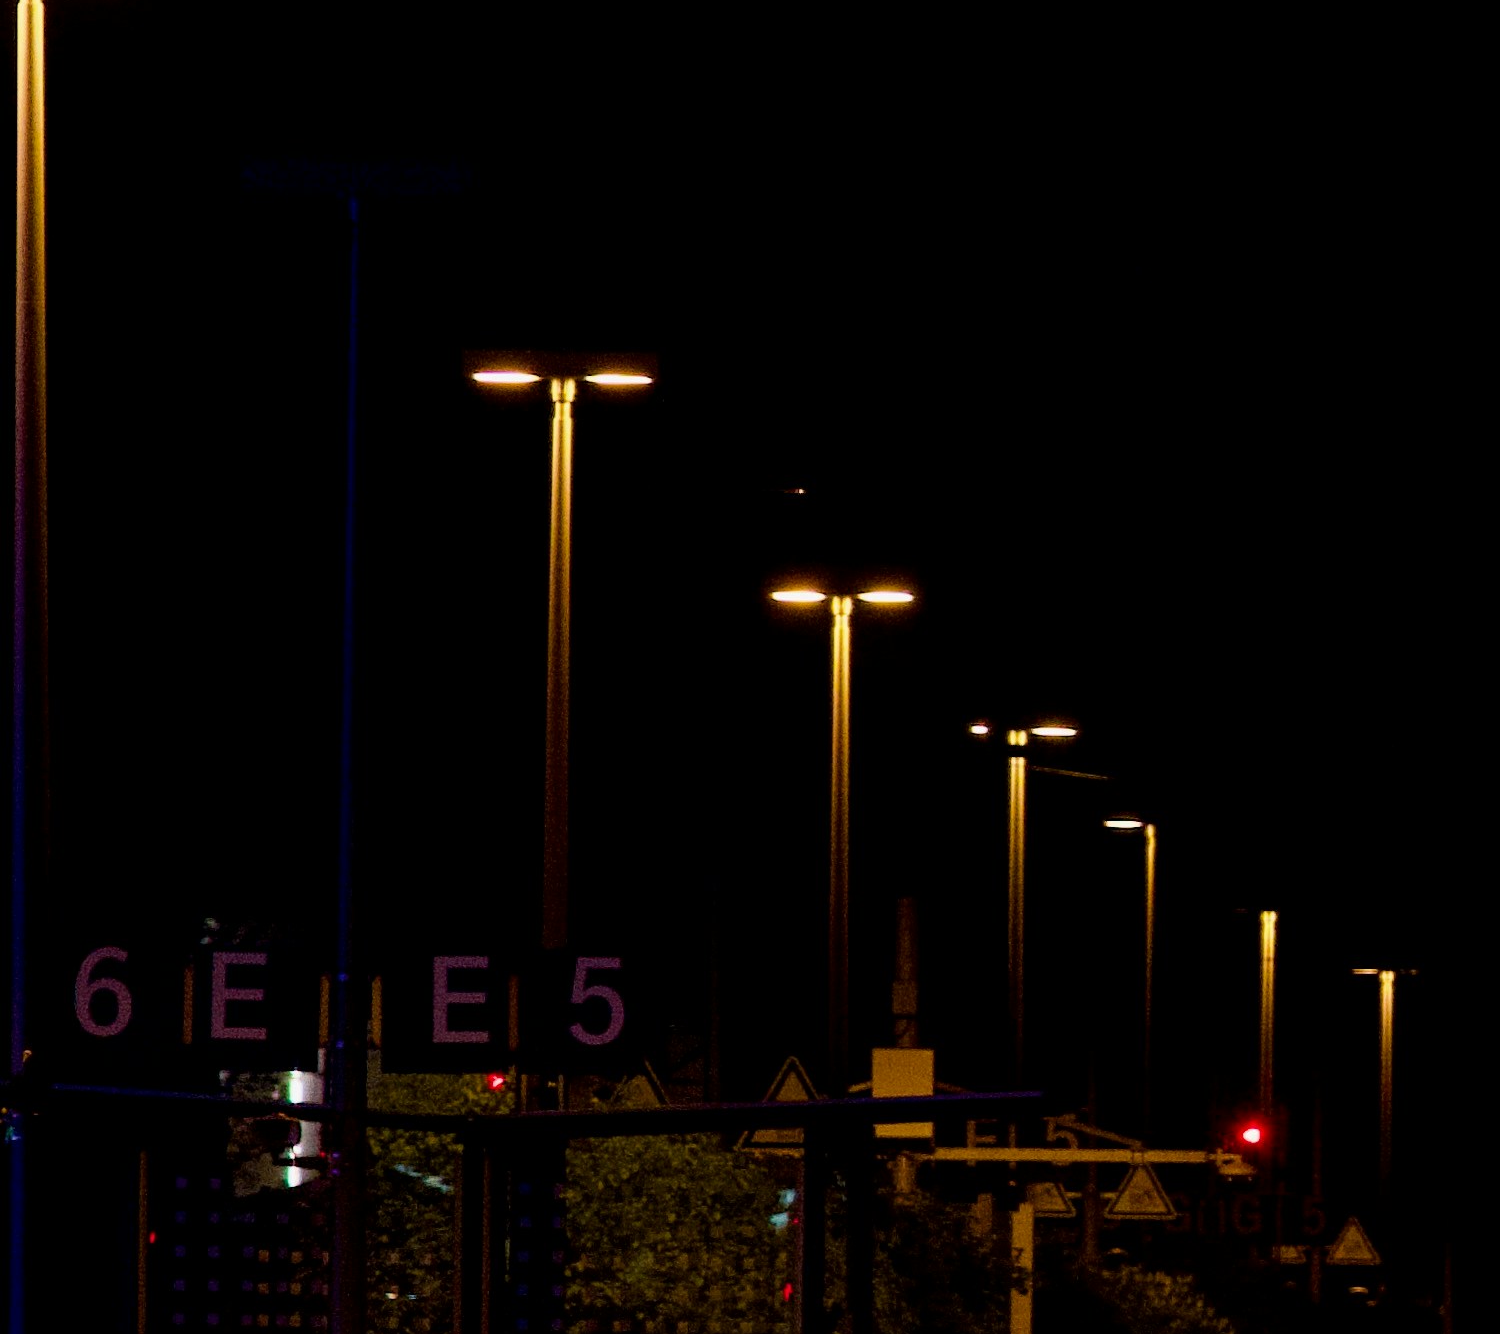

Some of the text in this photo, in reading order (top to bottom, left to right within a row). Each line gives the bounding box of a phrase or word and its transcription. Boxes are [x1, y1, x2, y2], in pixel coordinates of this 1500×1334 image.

[75, 946, 625, 1045] 6 E E 5
[1301, 1194, 1328, 1236] 5
